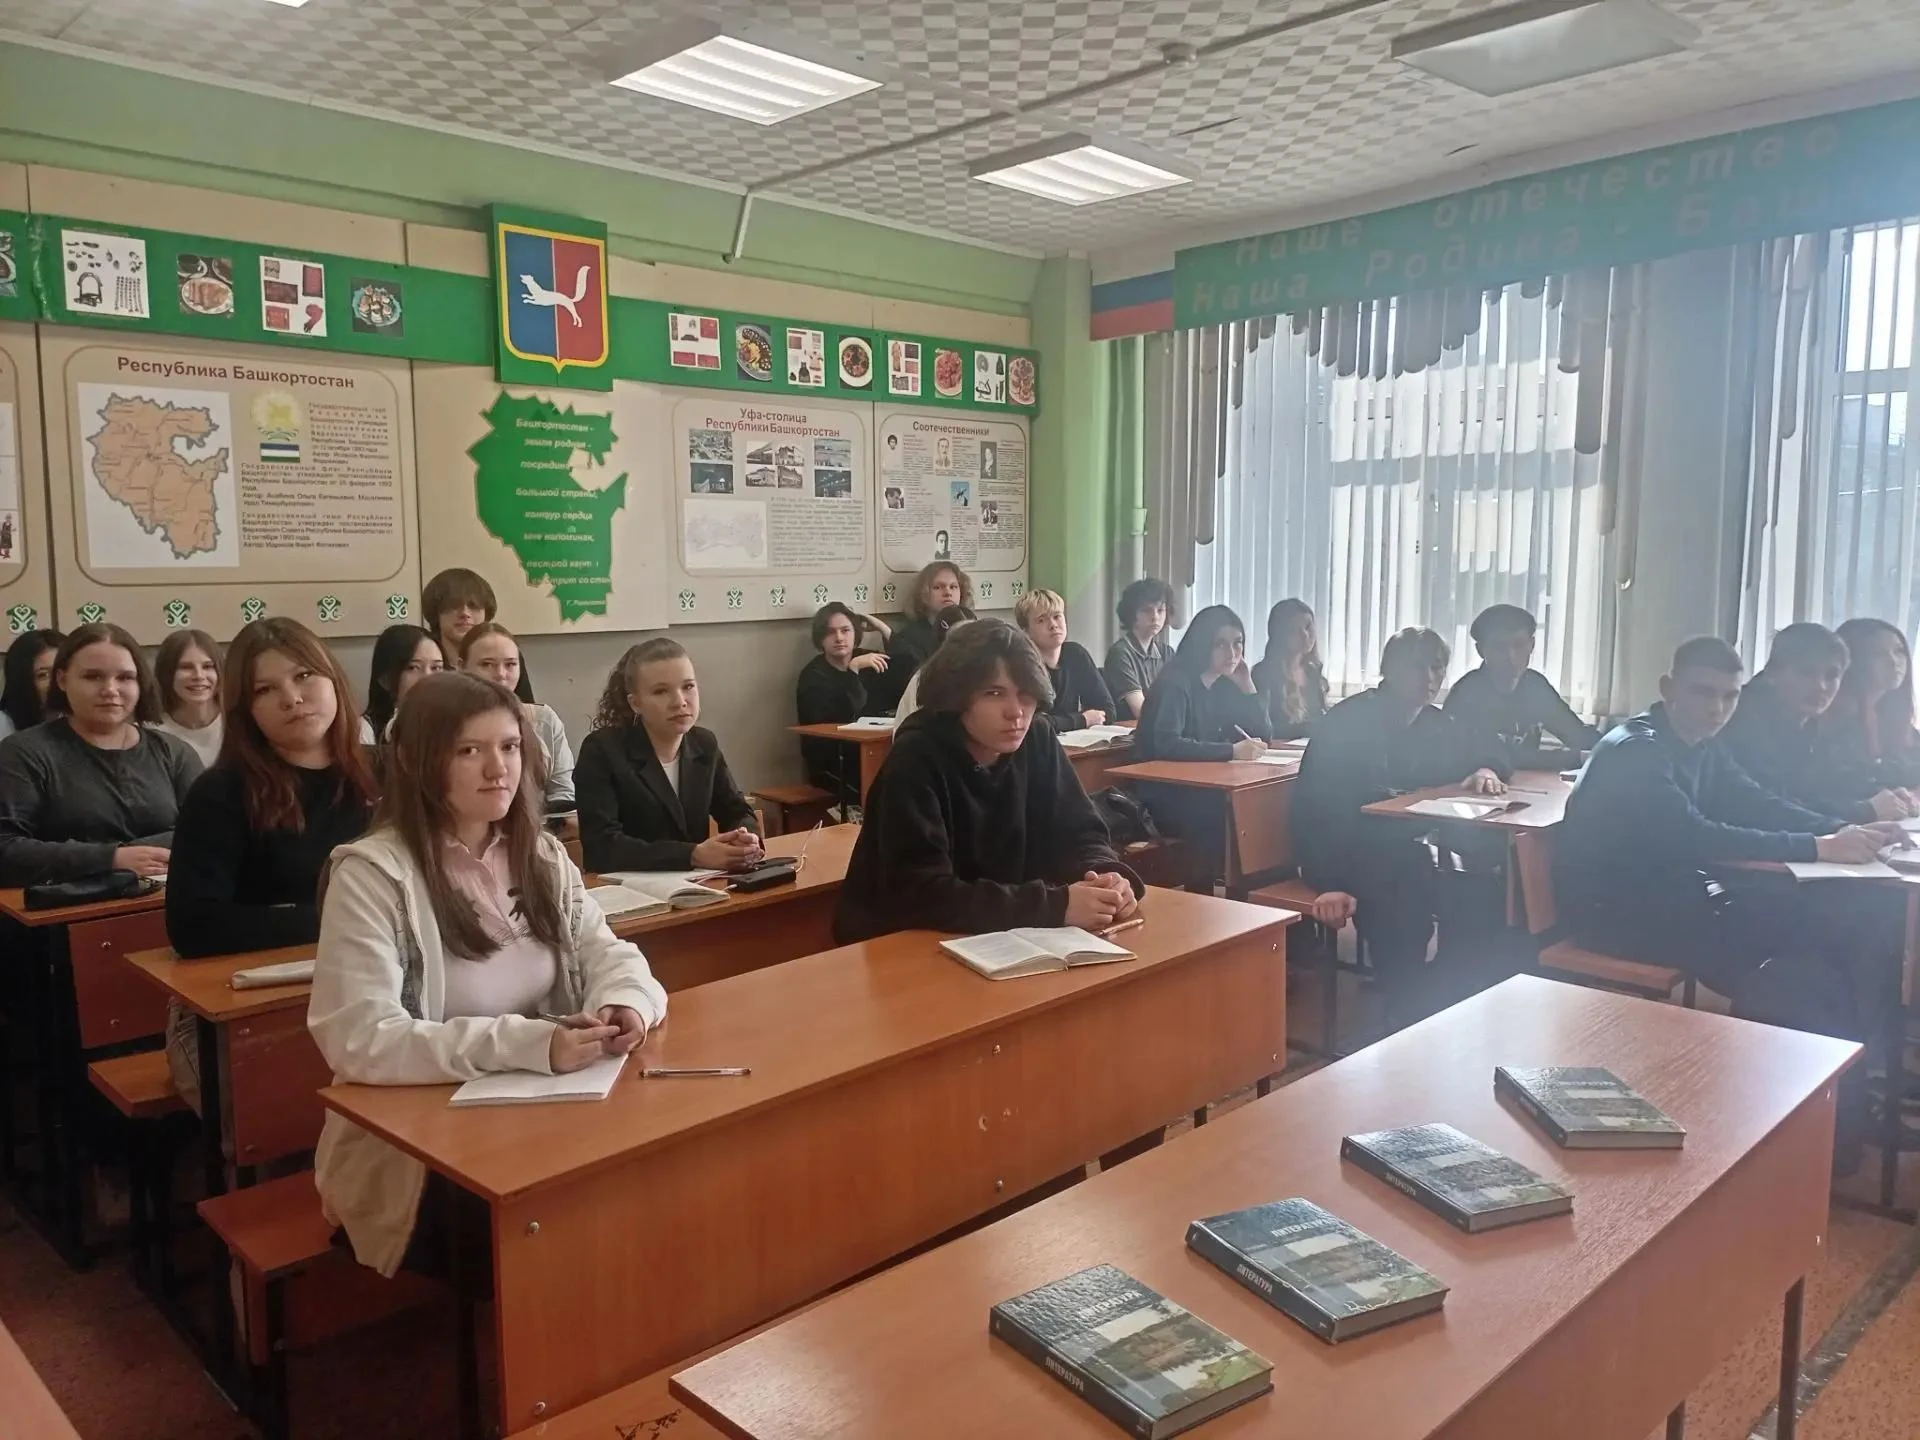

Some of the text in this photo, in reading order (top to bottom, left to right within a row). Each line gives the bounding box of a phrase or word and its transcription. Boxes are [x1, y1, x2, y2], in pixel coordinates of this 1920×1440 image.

[1235, 124, 1838, 266] Наше отечество
[1192, 272, 1309, 315] Наша
[1364, 225, 1579, 288] Родина
[117, 356, 355, 389] Республика Башкортостан
[705, 417, 840, 437] Республики Башкортостан
[912, 420, 990, 436] Соотечественники
[1236, 1263, 1273, 1295] ЛИТЕРАТУРА
[1044, 1356, 1085, 1393] ЛИТЕРАТУРА
